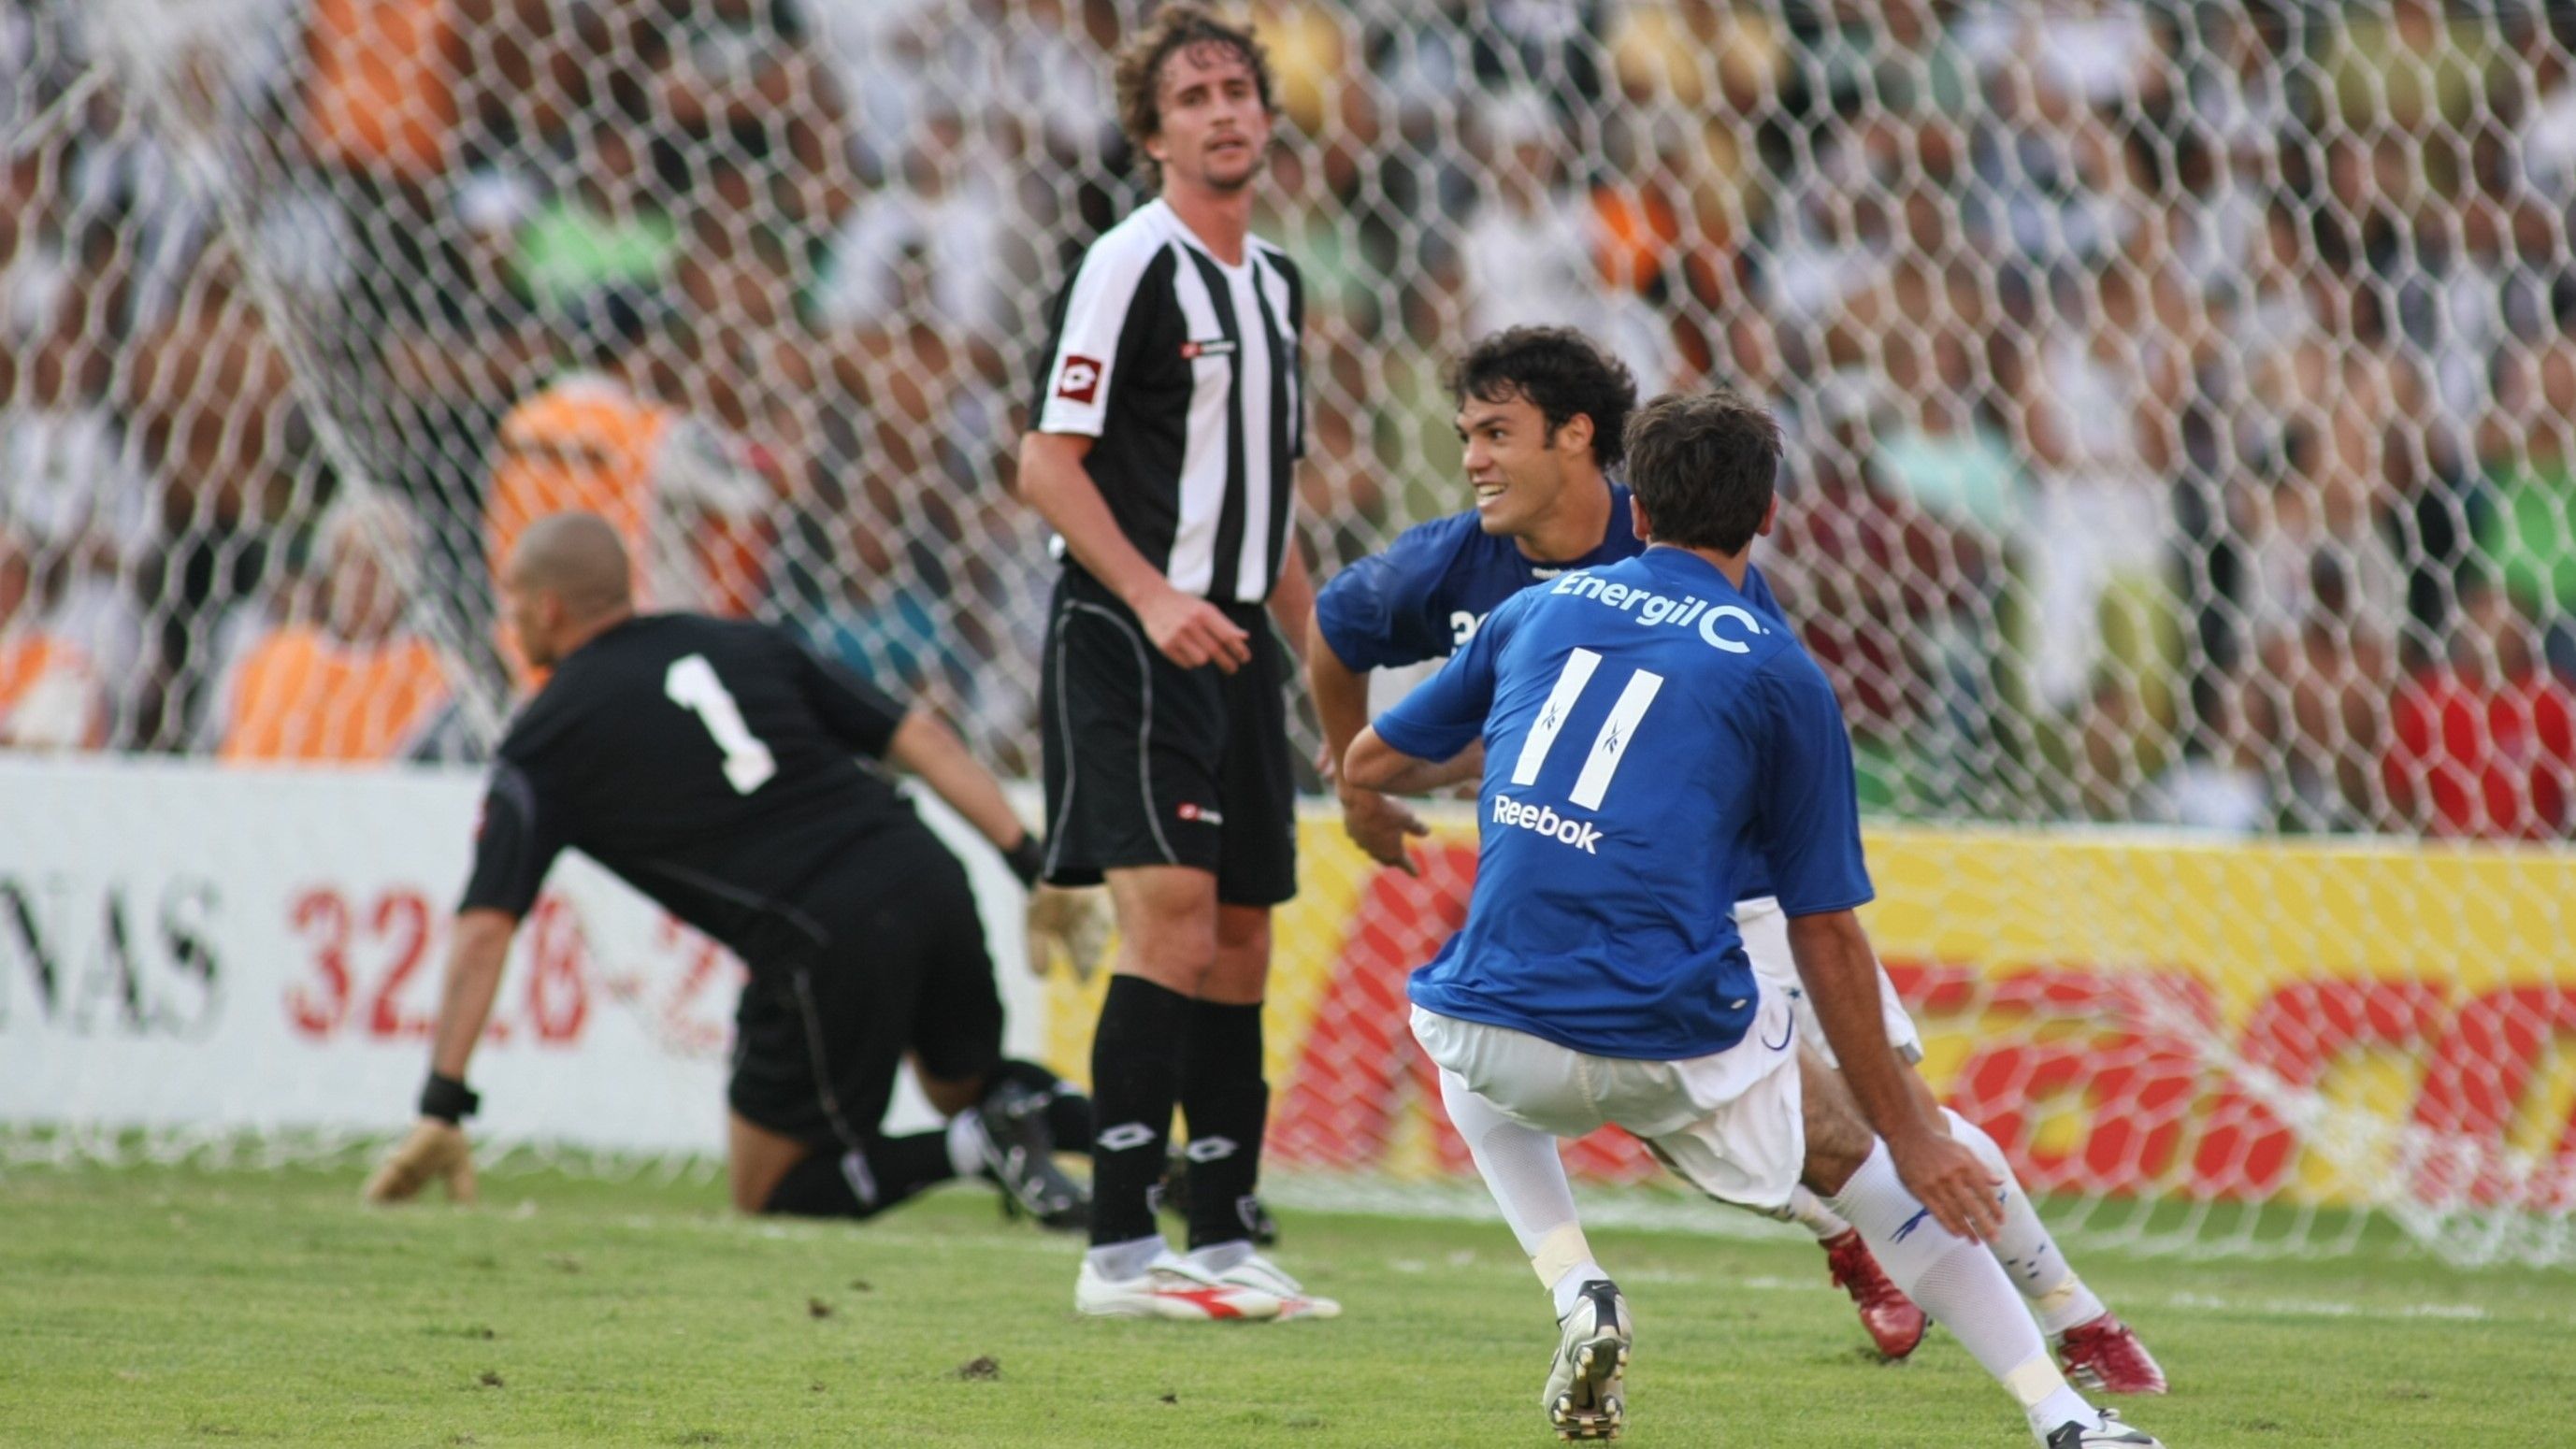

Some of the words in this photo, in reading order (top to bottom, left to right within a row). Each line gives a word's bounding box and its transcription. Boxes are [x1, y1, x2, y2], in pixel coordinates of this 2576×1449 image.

[1549, 571, 1762, 653] EnergilC
[664, 653, 778, 795] 1
[1510, 646, 1664, 811] 11
[1493, 795, 1604, 854] Reebok
